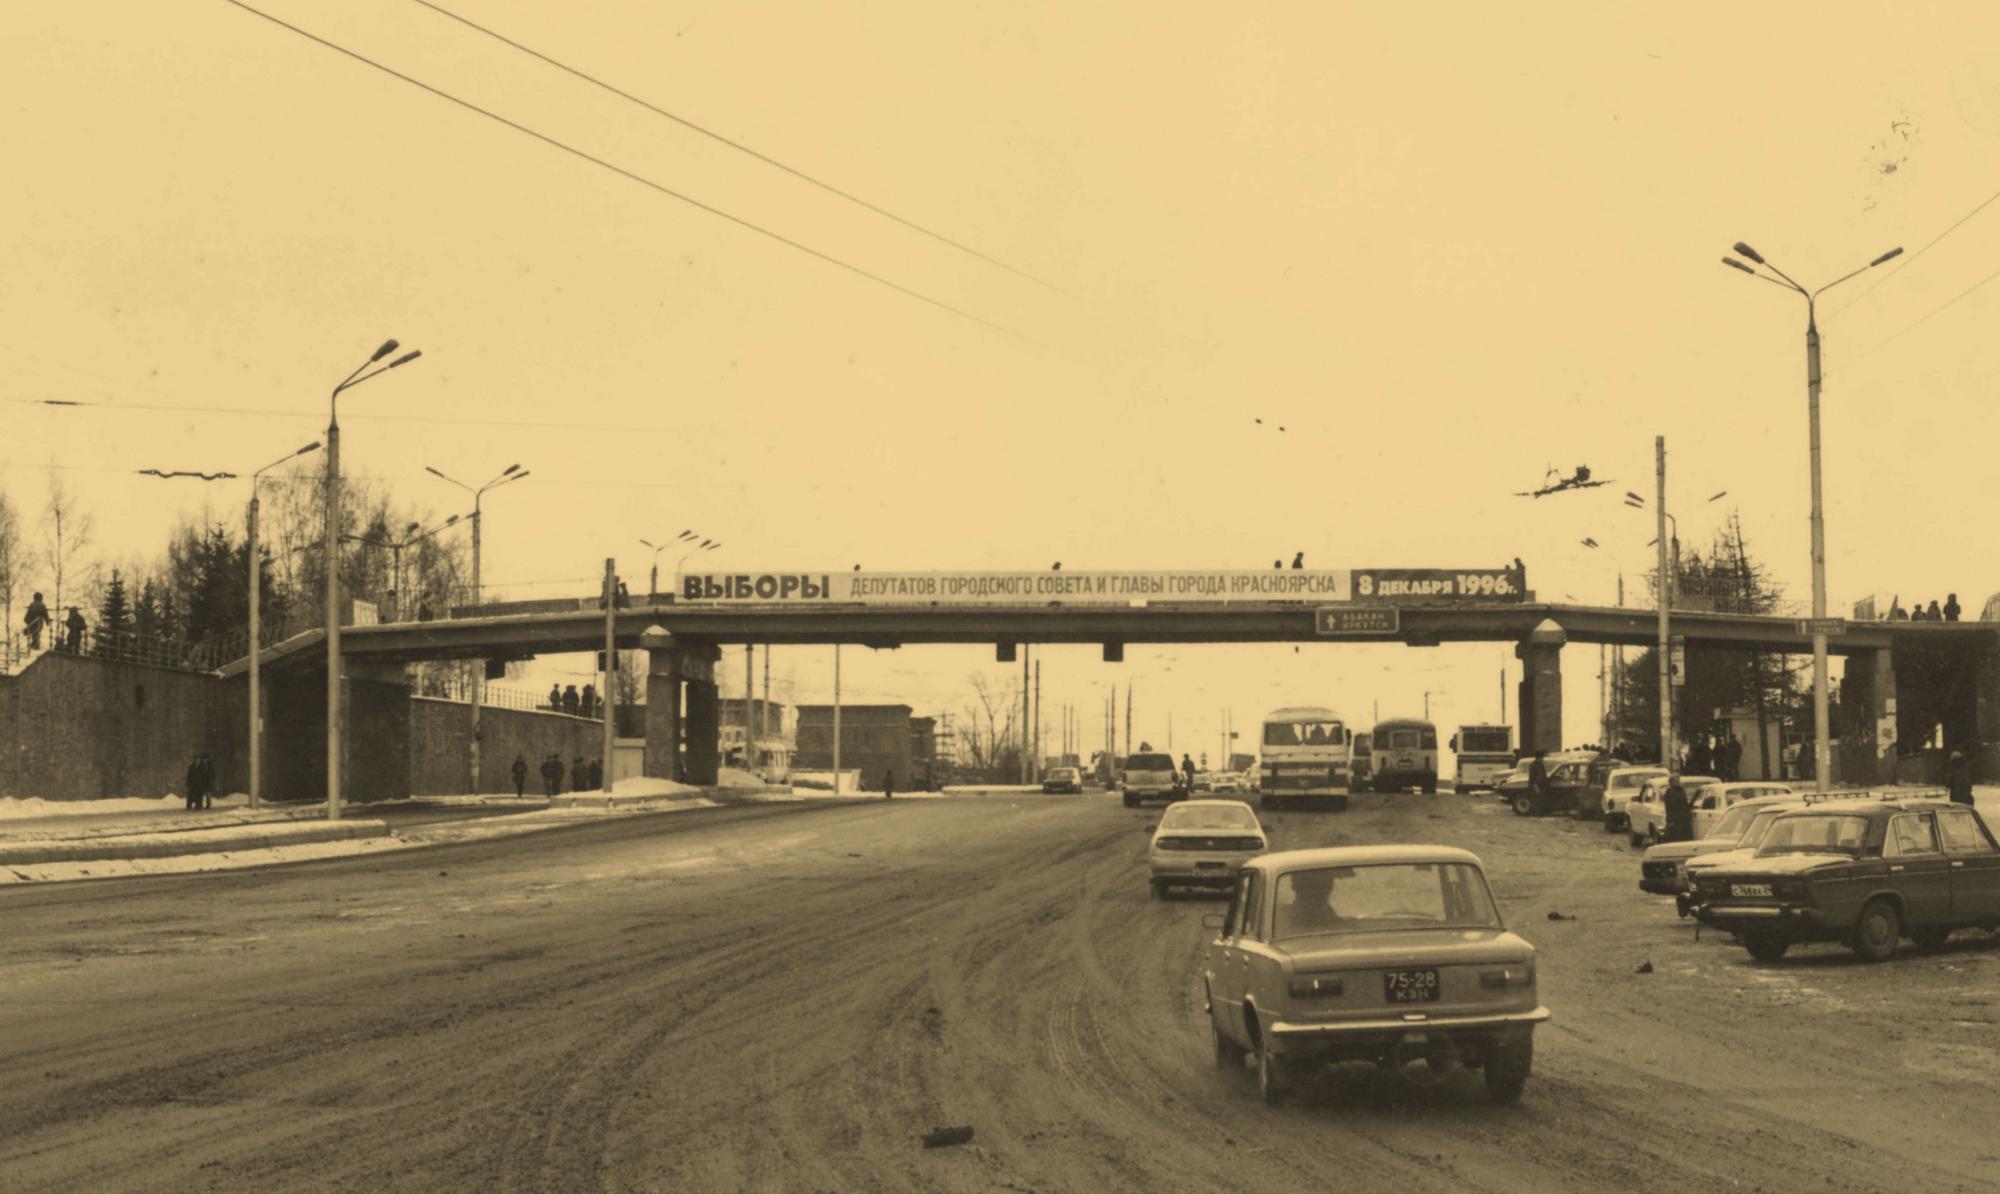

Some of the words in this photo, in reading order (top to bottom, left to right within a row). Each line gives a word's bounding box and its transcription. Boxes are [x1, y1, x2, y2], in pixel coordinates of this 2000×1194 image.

[684, 575, 830, 599] ВЫБОРЫ
[850, 577, 936, 597] ДЕПУТАТОВ
[940, 577, 1033, 597] ГОРОДСКОГО
[1037, 576, 1093, 595] СОВЕТА
[1097, 576, 1105, 594] И
[1111, 576, 1164, 594] ГЛАВЫ
[1168, 575, 1227, 595] ГОРОДА
[1231, 575, 1336, 593] КРАСНОЯРСКА
[1358, 574, 1374, 595] 8
[1378, 580, 1453, 596] ДЕКАБРЯ
[1387, 971, 1437, 989] 75-28
